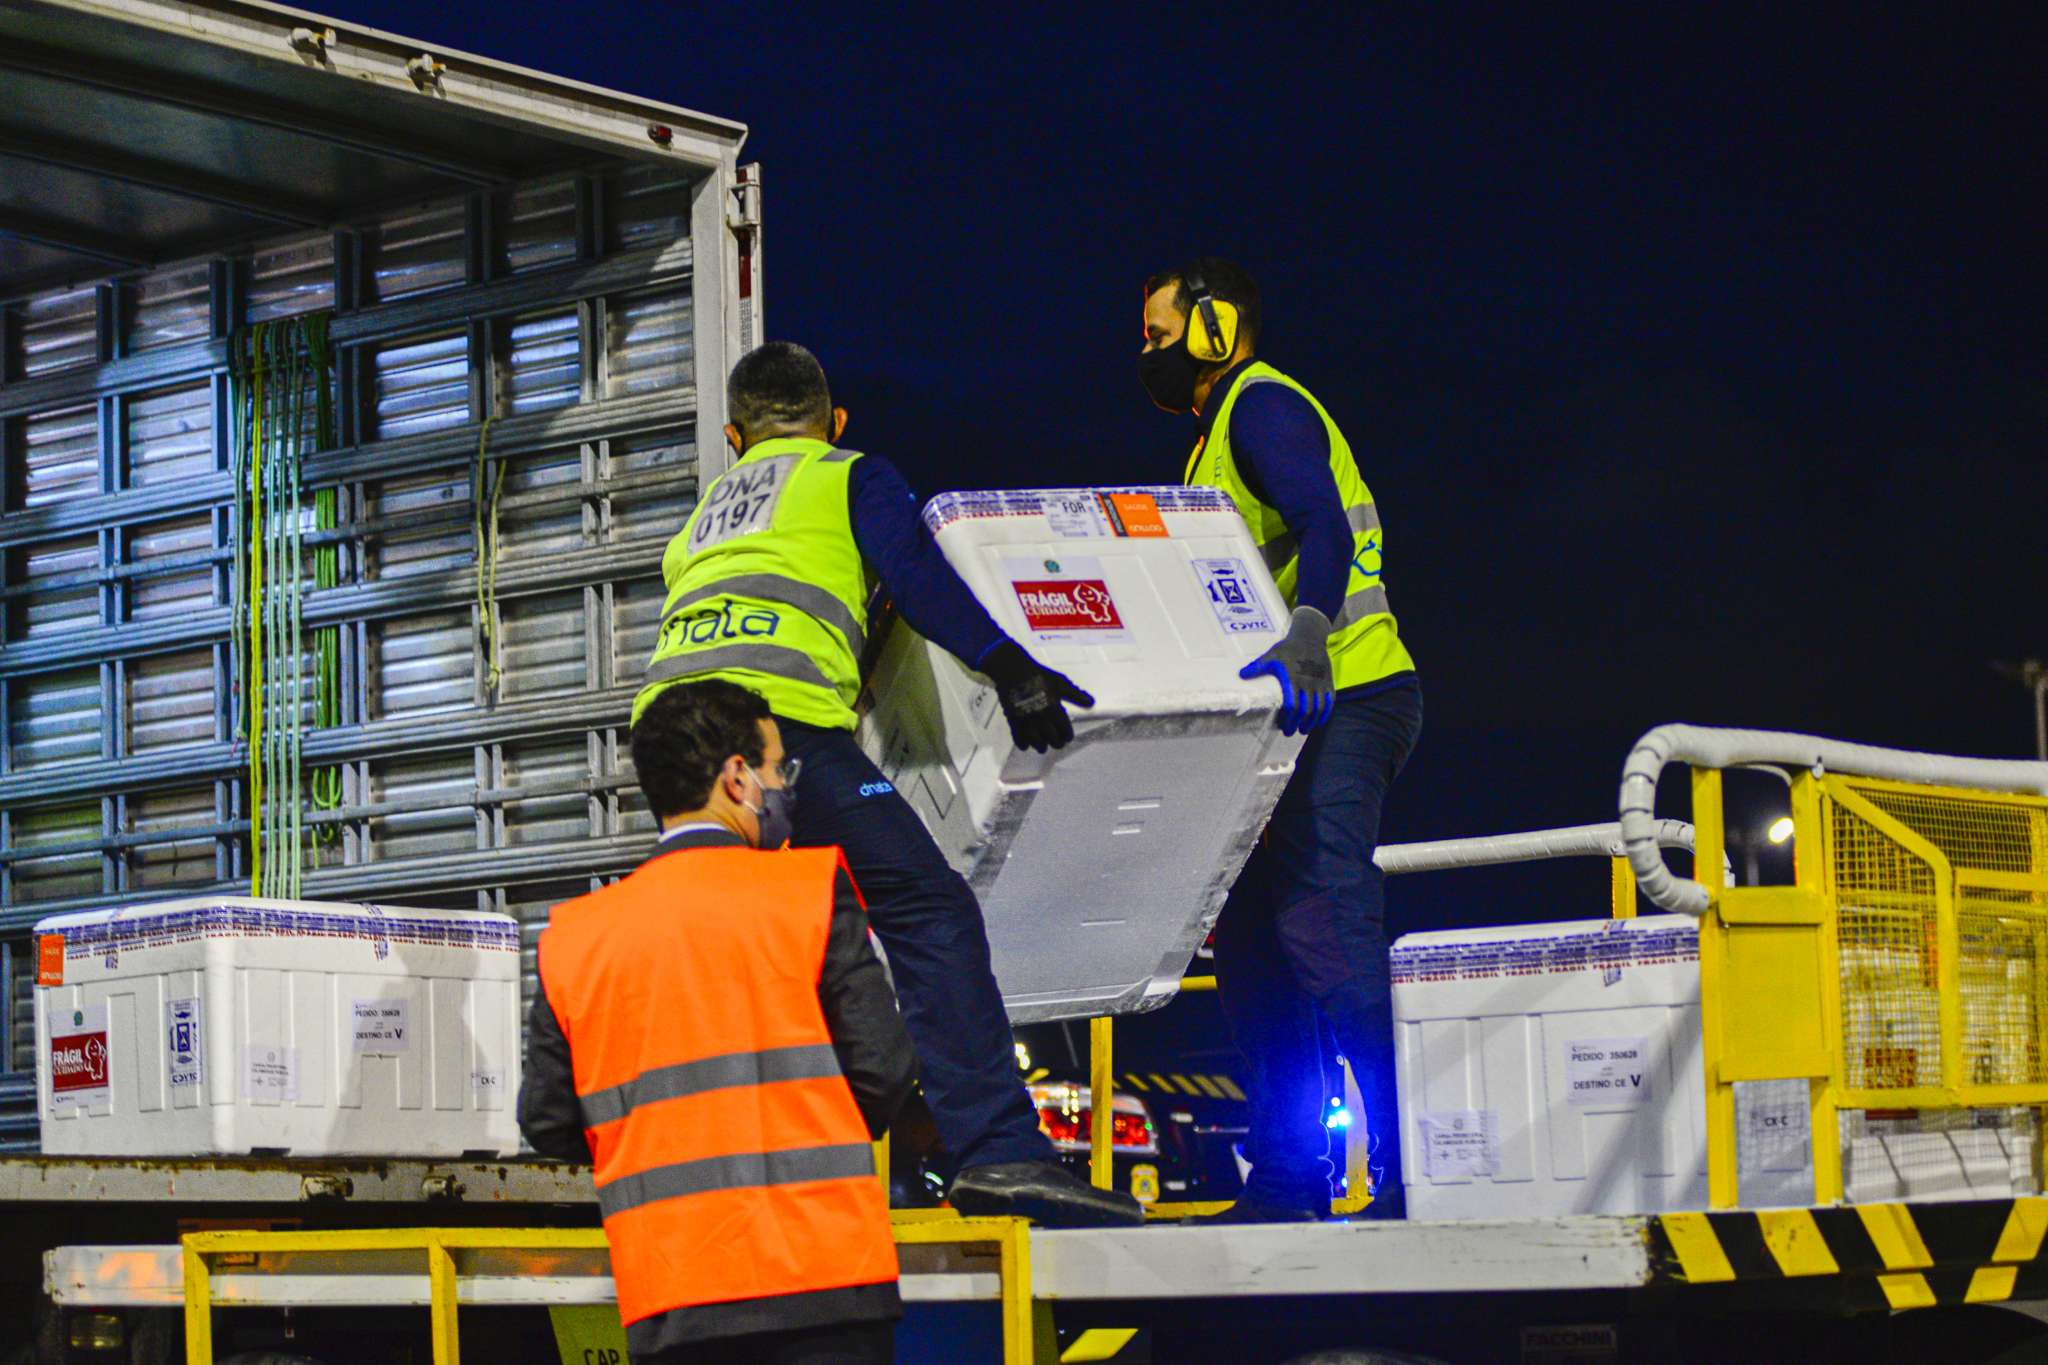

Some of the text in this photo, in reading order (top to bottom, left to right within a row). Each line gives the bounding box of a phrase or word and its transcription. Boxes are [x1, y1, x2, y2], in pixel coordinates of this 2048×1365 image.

[709, 463, 777, 505] DNA
[1061, 501, 1086, 513] FOR
[695, 493, 771, 543] 0197
[1019, 589, 1074, 608] FRÁGIL
[1025, 606, 1077, 616] CUIDADO
[53, 1046, 84, 1066] FRÁGIL
[1630, 1074, 1641, 1087] V
